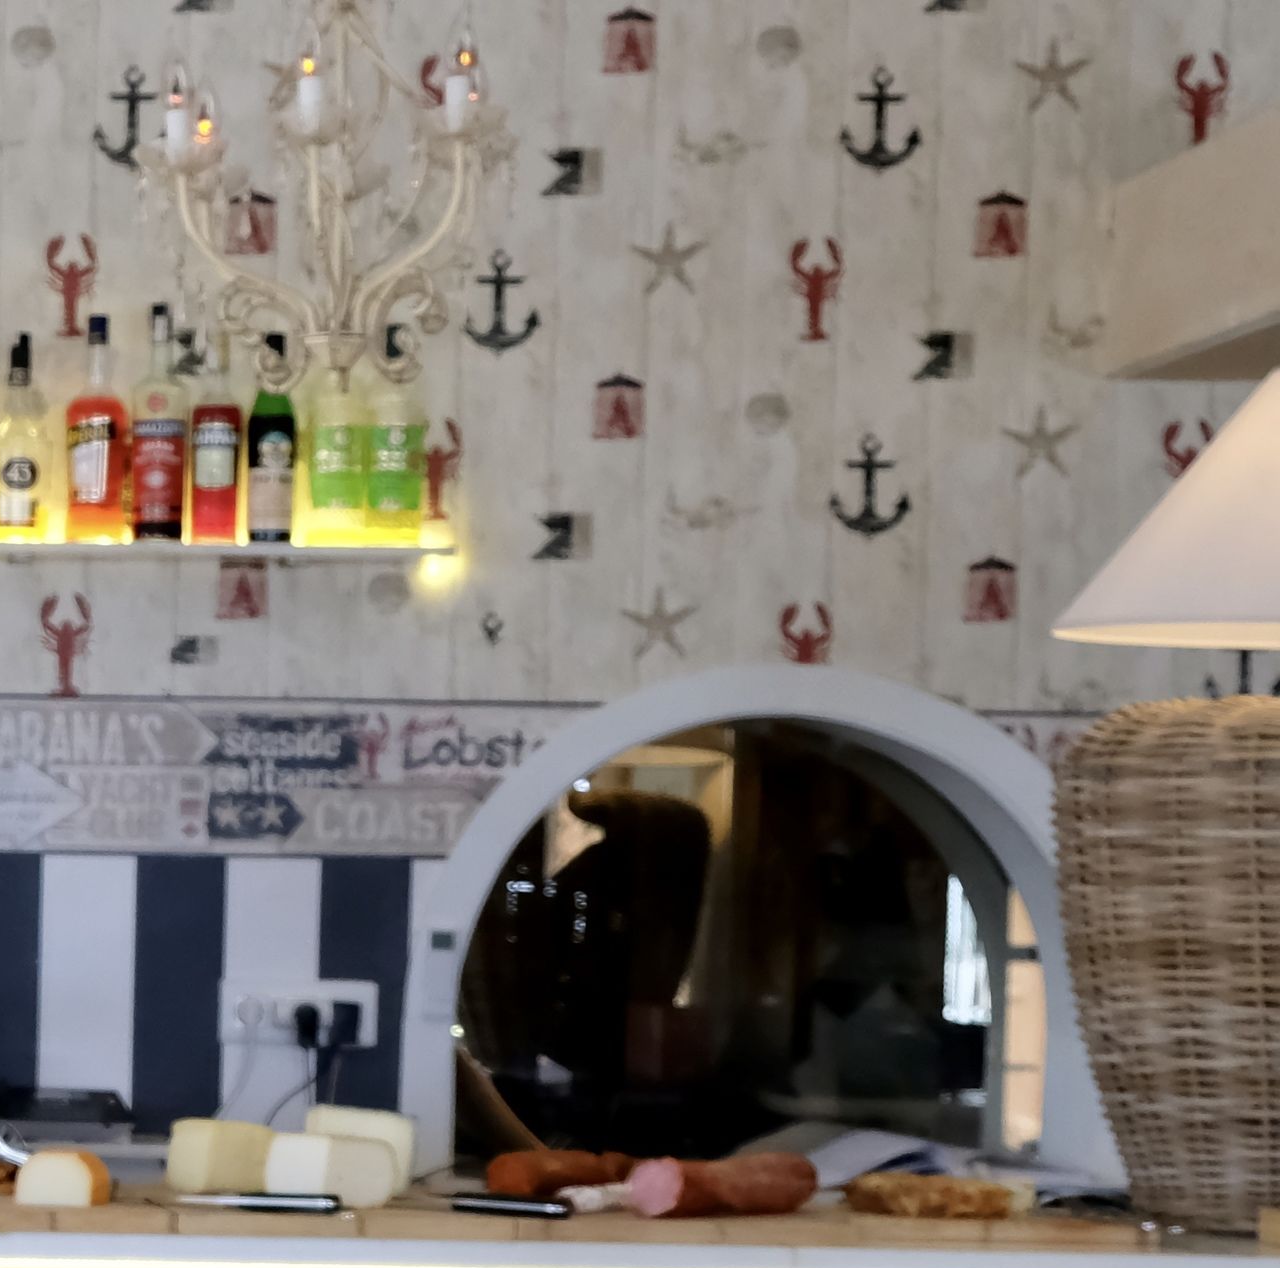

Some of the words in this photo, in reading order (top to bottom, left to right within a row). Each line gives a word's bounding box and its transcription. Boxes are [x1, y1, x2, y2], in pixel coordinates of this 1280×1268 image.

[6, 463, 32, 482] 43
[223, 726, 342, 759] seaside
[403, 726, 546, 770] Lobst
[312, 798, 467, 843] COAST
